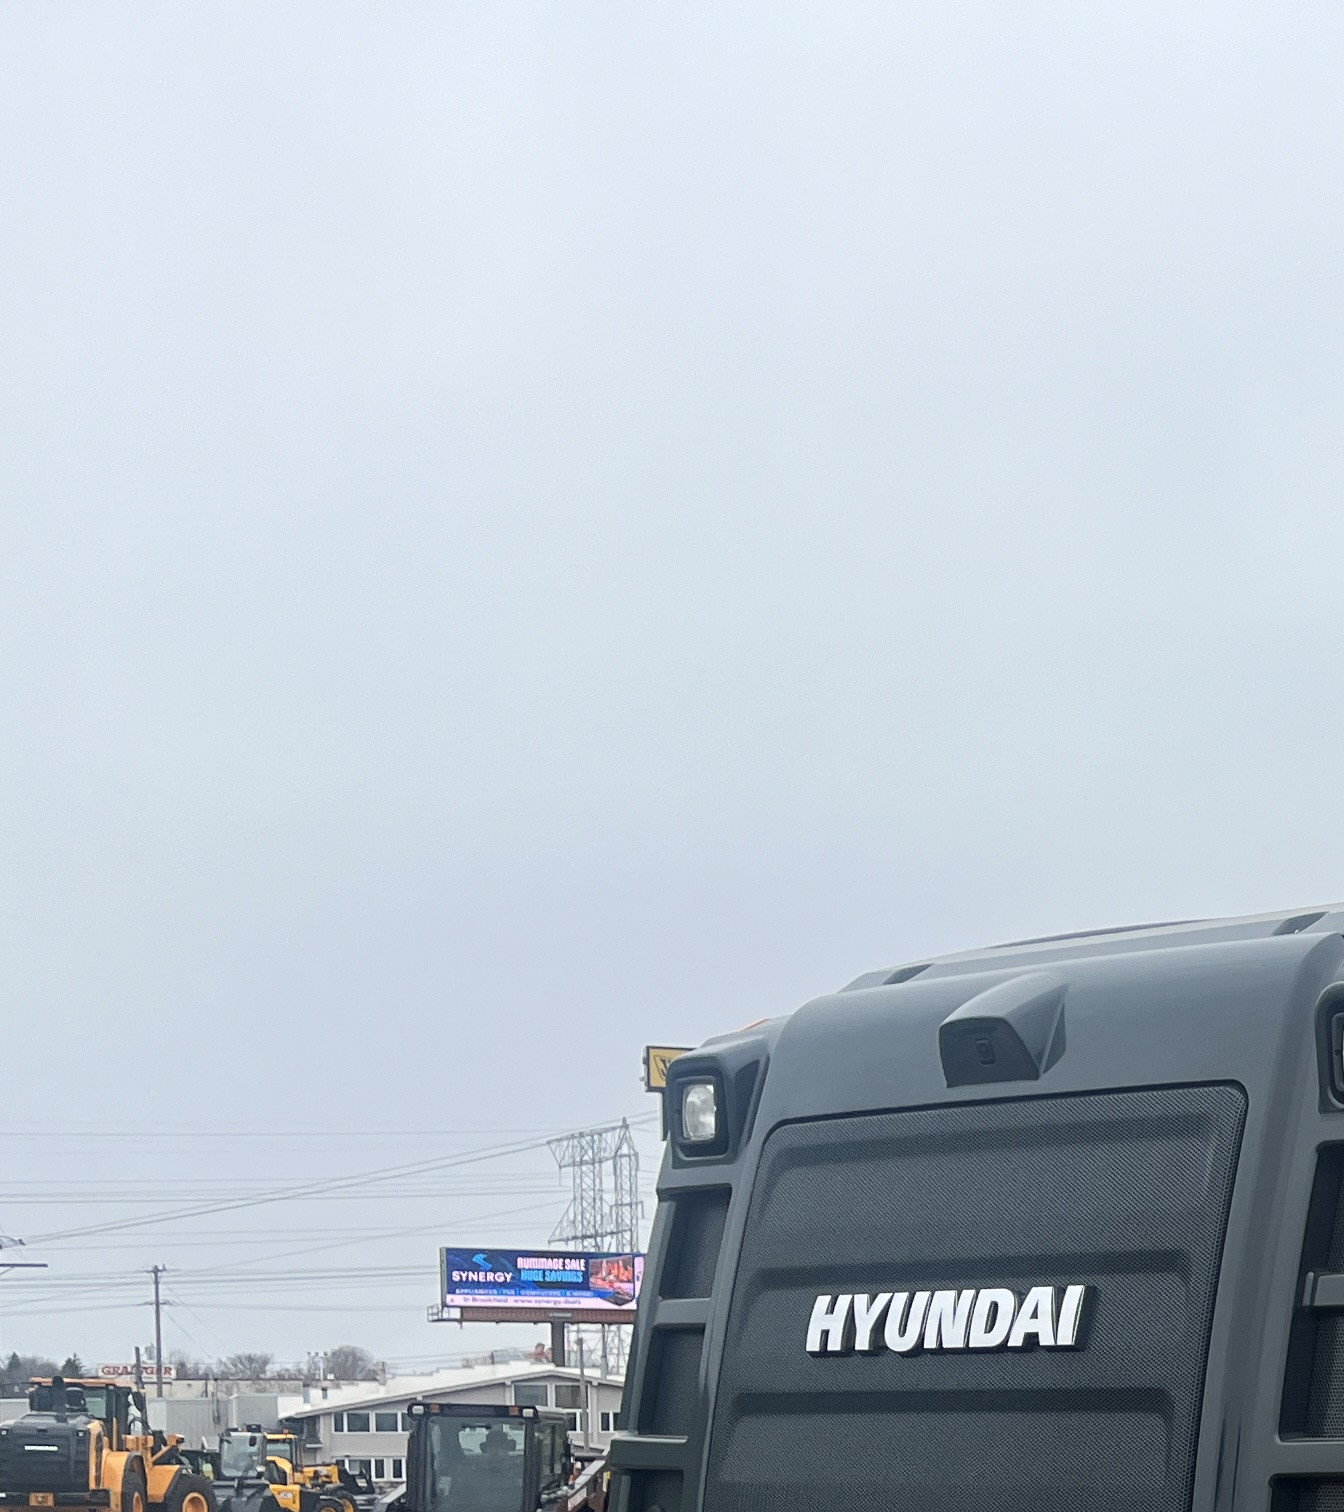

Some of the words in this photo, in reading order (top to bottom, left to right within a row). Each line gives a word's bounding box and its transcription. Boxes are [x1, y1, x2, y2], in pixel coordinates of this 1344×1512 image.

[565, 1258, 586, 1271] SALE
[452, 1270, 513, 1283] SYNERGY
[805, 1284, 1086, 1352] HYUNDAI
